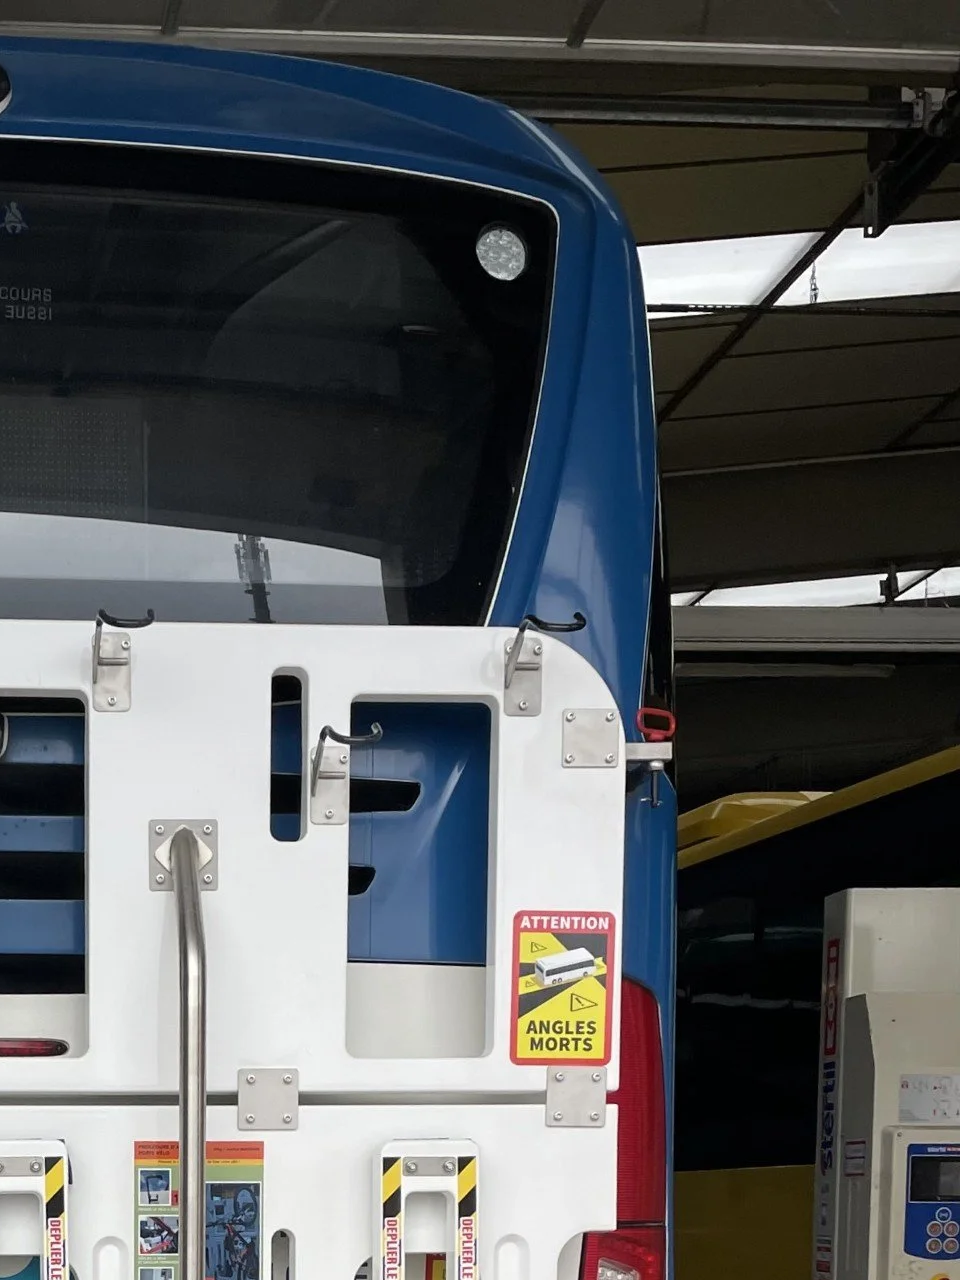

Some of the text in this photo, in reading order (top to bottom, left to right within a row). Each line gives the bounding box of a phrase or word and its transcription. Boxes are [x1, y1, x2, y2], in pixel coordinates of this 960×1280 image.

[520, 916, 609, 930] ATTENTION
[526, 1020, 597, 1035] ANGLES
[530, 1037, 593, 1052] MORTS
[50, 1220, 61, 1265] DEPLIER
[386, 1220, 398, 1265] DEPLIER
[461, 1219, 473, 1264] DEPLIER
[51, 1268, 62, 1280] LE
[386, 1266, 398, 1279] LE
[462, 1266, 473, 1279] LE
